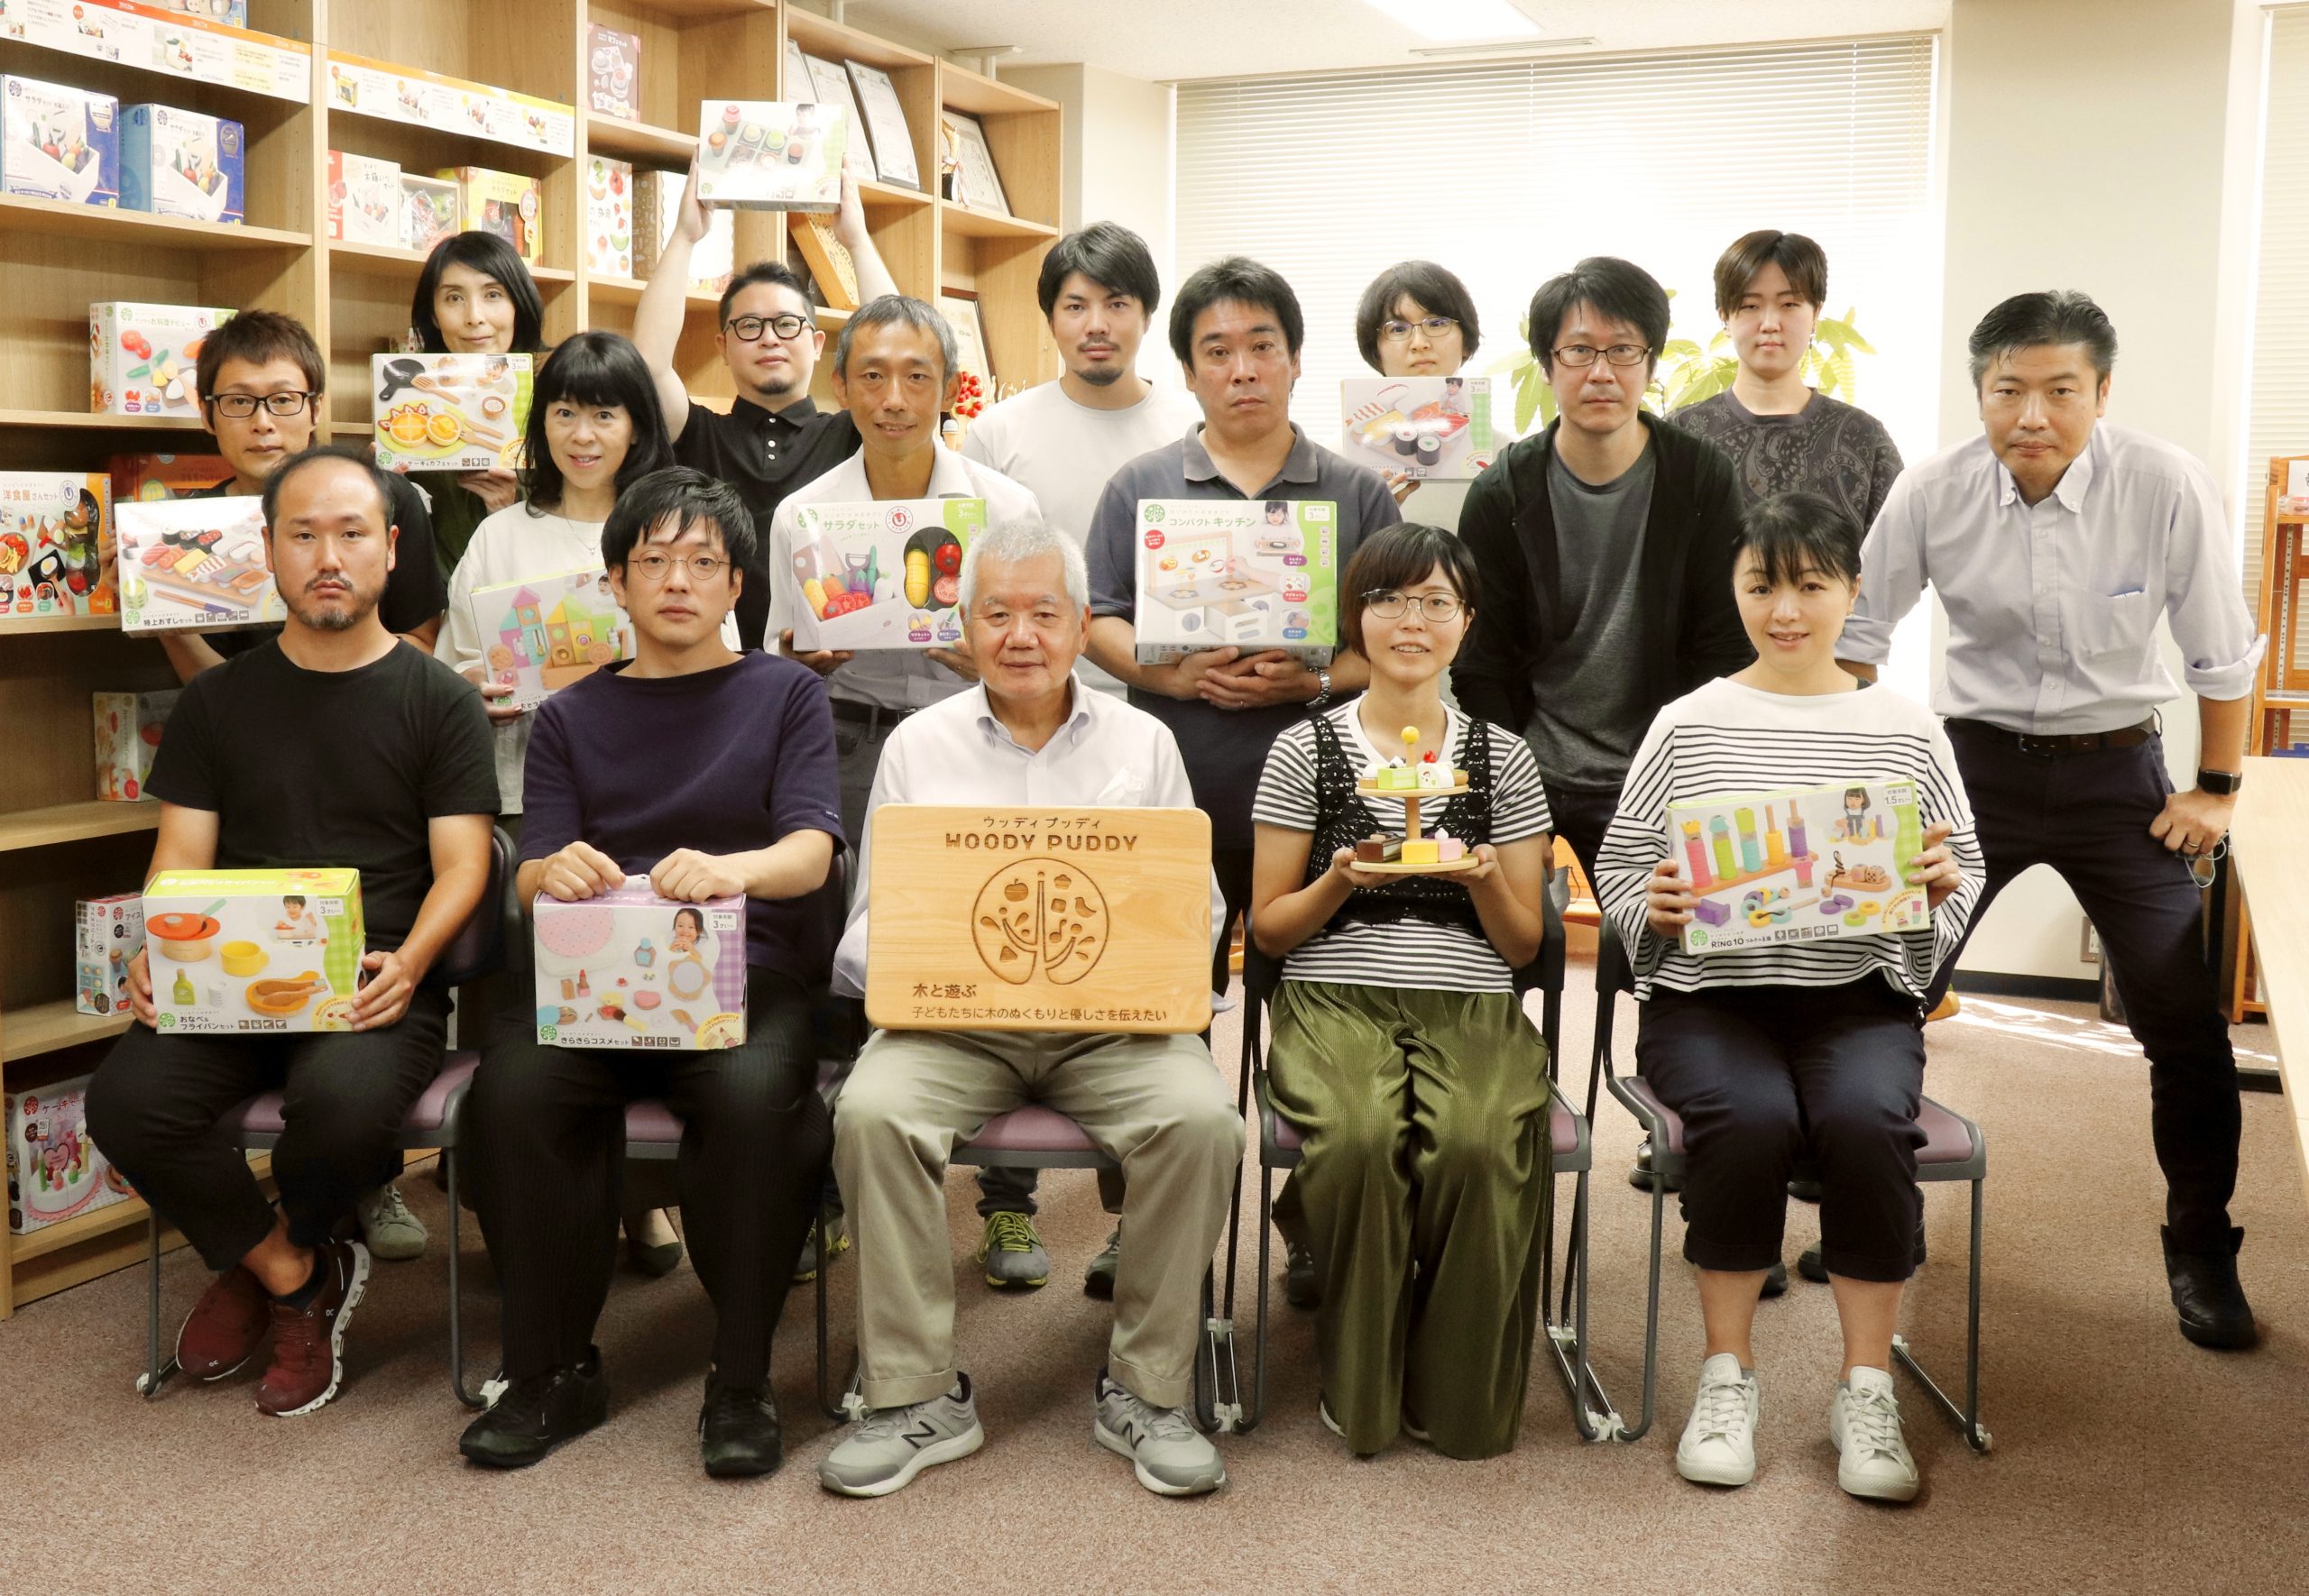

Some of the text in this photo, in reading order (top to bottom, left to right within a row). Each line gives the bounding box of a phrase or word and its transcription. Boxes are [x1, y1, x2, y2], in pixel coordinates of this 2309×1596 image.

[823, 519, 879, 531] サラダセット
[143, 618, 193, 627] 特上おすしセット
[944, 832, 1138, 852] WOODY PUDDY
[125, 912, 143, 921] アイス
[1734, 938, 1744, 946] 10
[912, 983, 978, 999] 木と遊ぶ
[912, 1005, 1167, 1022] 子どもたちに木のぬくもりと優しさを伝えたい
[180, 1023, 235, 1031] フライパンセット
[561, 1037, 630, 1046] きらきらコスメセット
